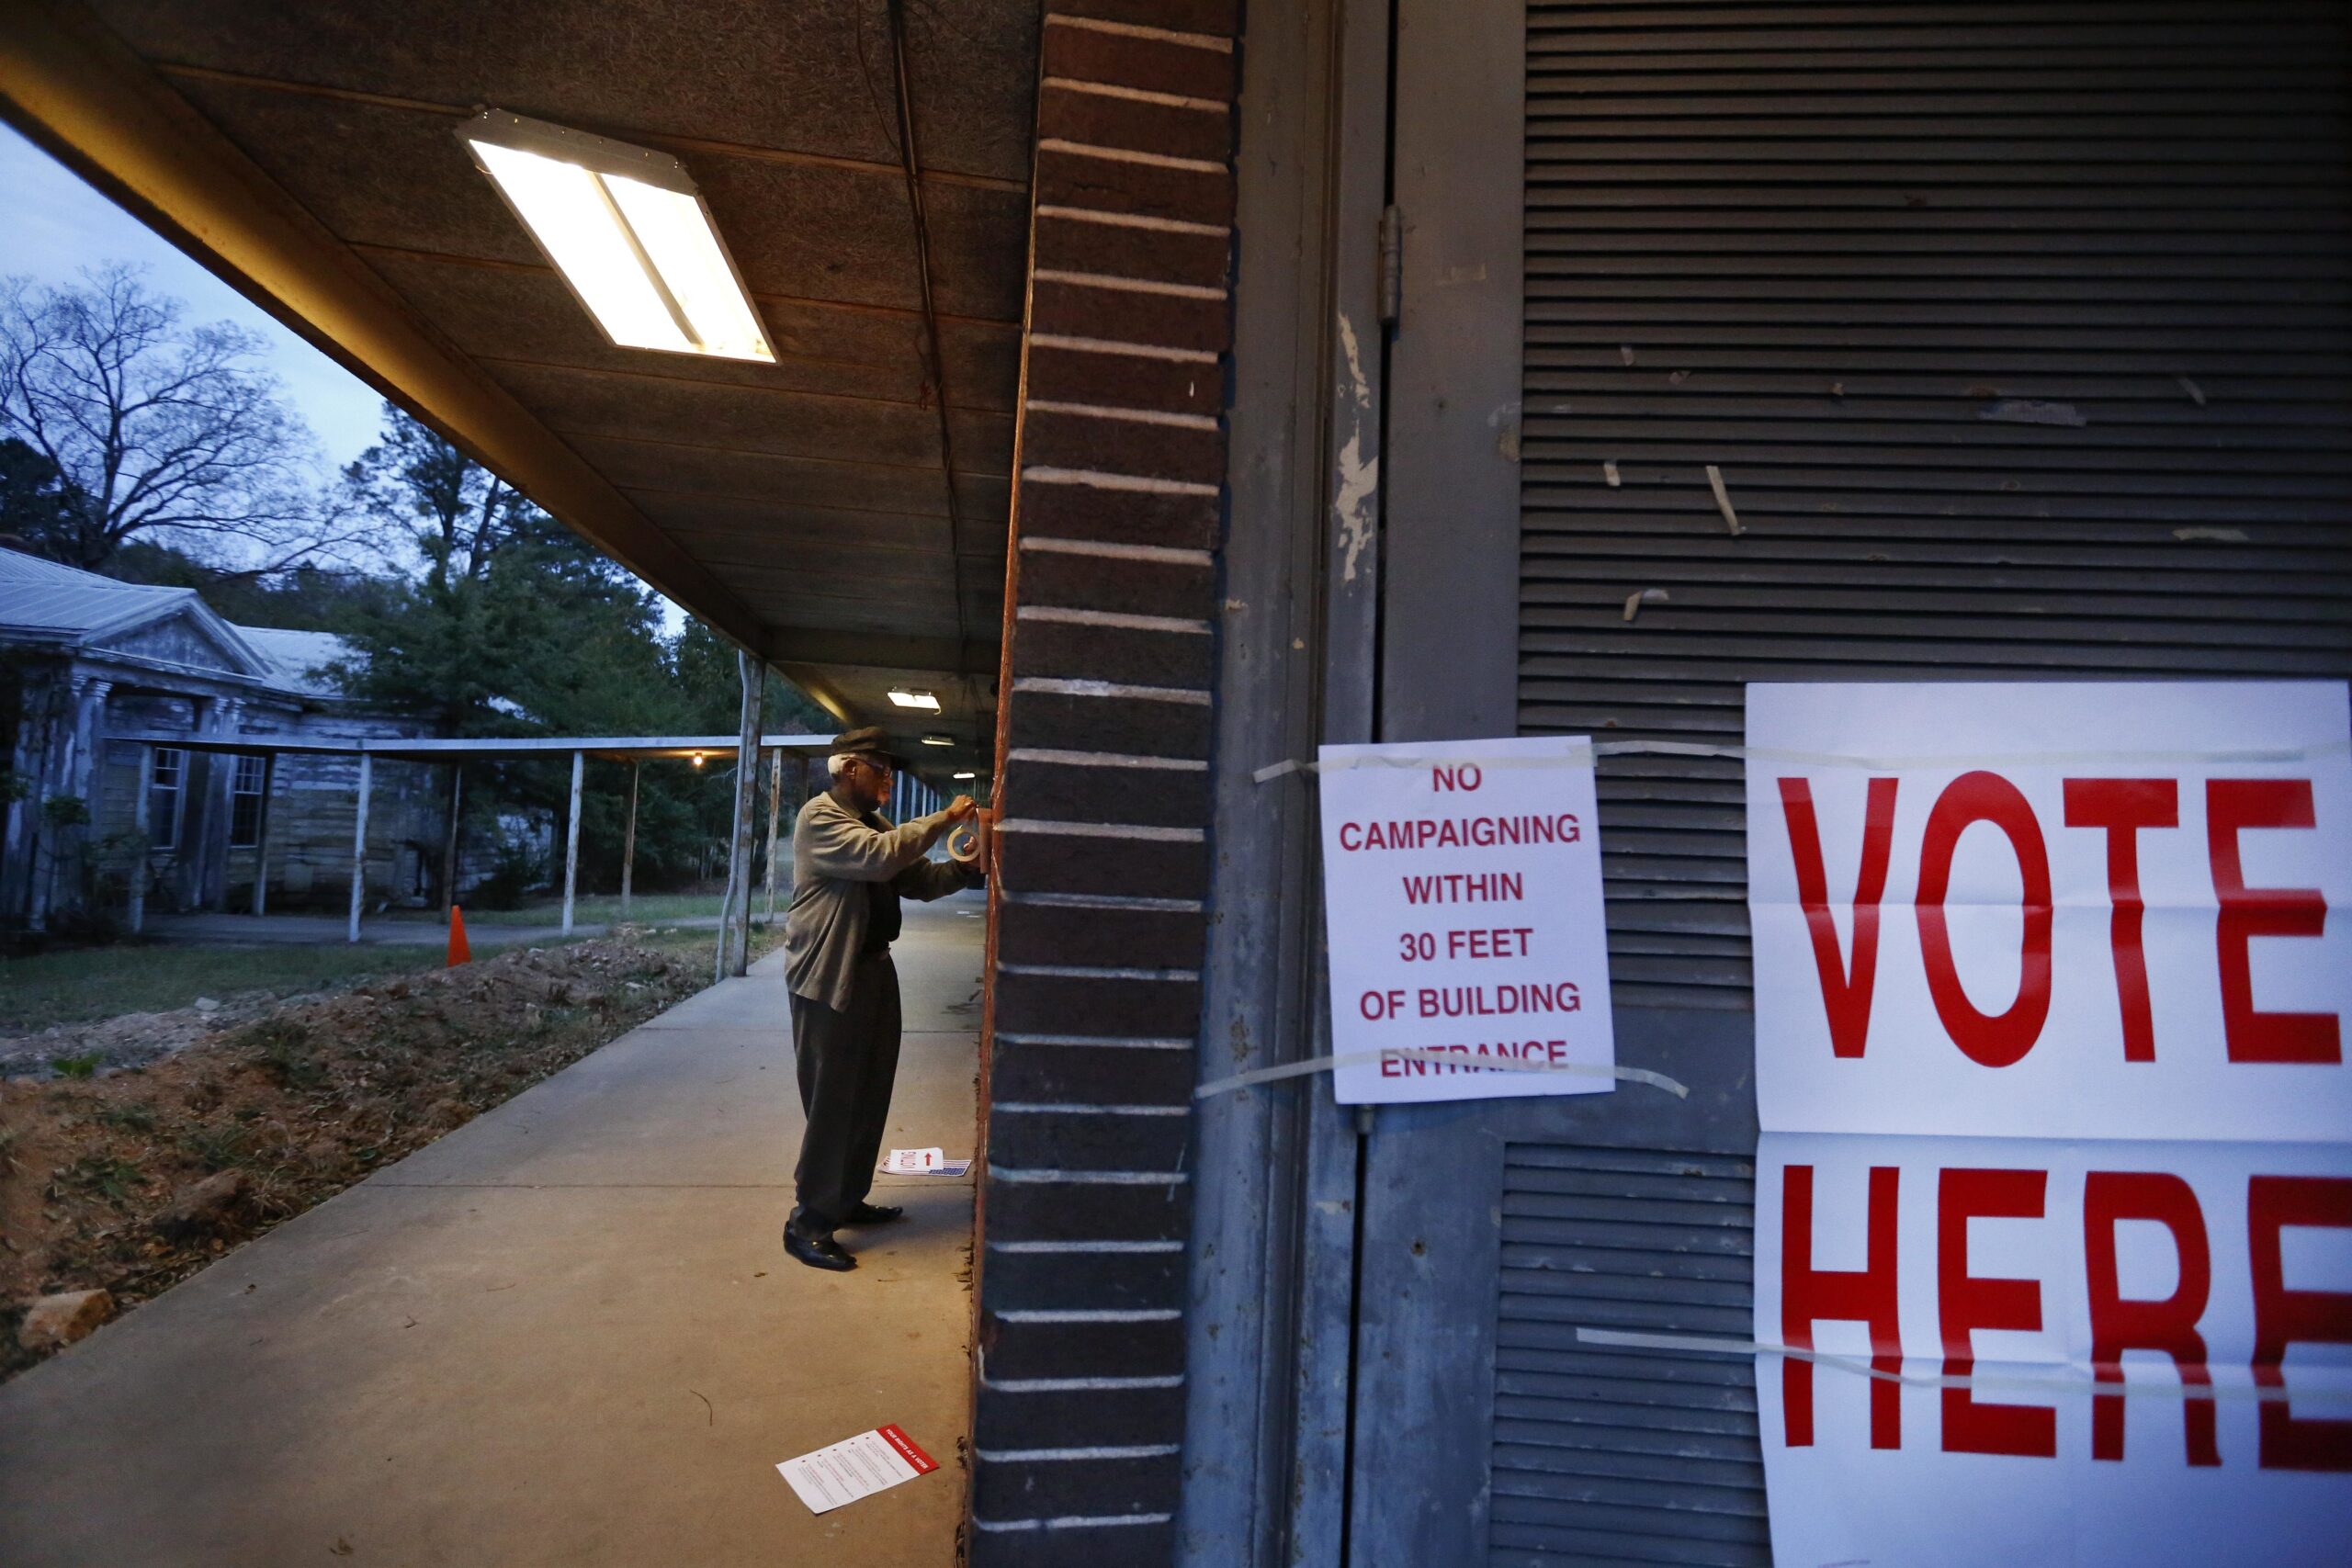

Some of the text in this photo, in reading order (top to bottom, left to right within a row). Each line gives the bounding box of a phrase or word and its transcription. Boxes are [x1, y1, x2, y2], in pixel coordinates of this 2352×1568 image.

[1432, 762, 1482, 792] NO
[1340, 814, 1580, 851] CAMPAIGNING
[1403, 873, 1523, 904] WITHIN
[1778, 771, 2342, 1068] VOTE
[1399, 929, 1533, 962] 30 FEET
[1360, 982, 1581, 1021] OF BUILDING
[1782, 1165, 2352, 1471] HERE
[886, 1428, 898, 1439] YOUR
